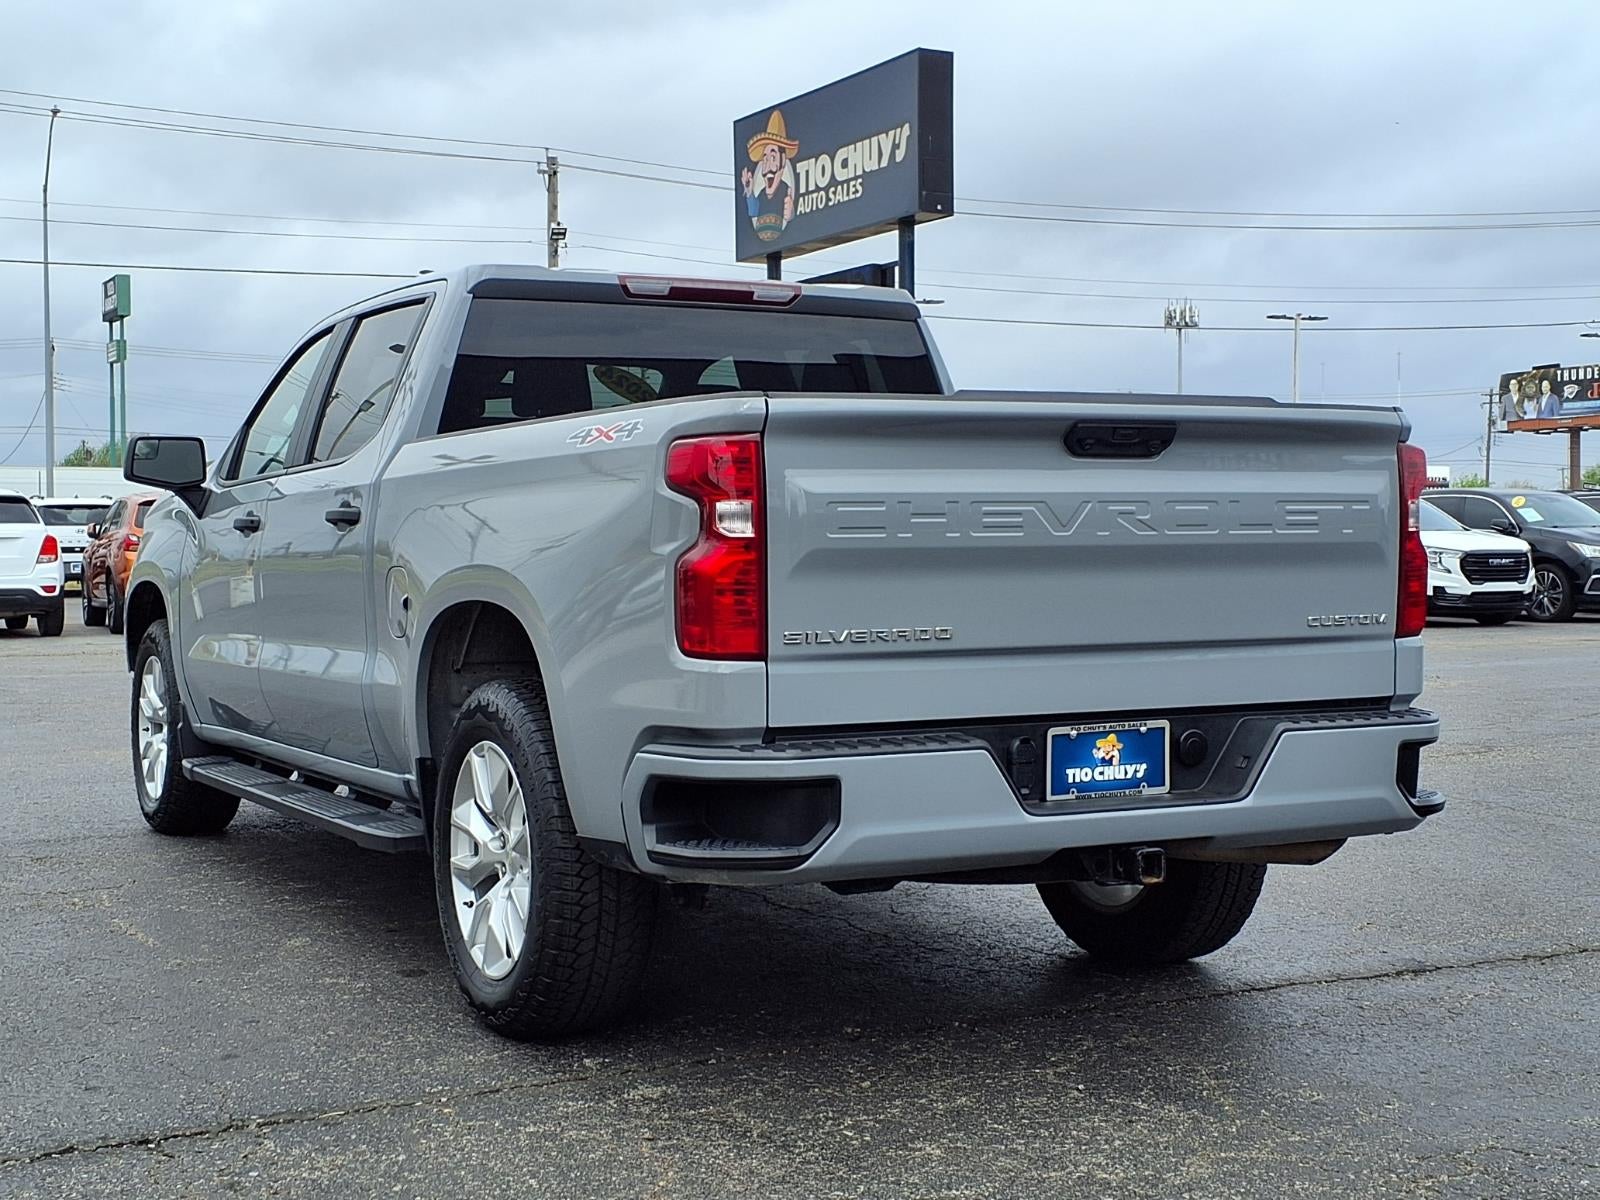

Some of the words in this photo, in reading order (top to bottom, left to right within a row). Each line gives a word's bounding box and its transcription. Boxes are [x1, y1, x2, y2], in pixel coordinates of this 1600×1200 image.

[796, 154, 832, 194] TIO
[833, 122, 911, 182] CHUY'S
[797, 193, 826, 216] AUTO
[828, 179, 863, 206] SALES
[825, 500, 1371, 537] CHEVROLET
[783, 625, 953, 646] SILVERADO
[1306, 613, 1388, 629] CUSTOM
[1065, 767, 1092, 783] TIO
[1093, 763, 1148, 782] CHUY'S
